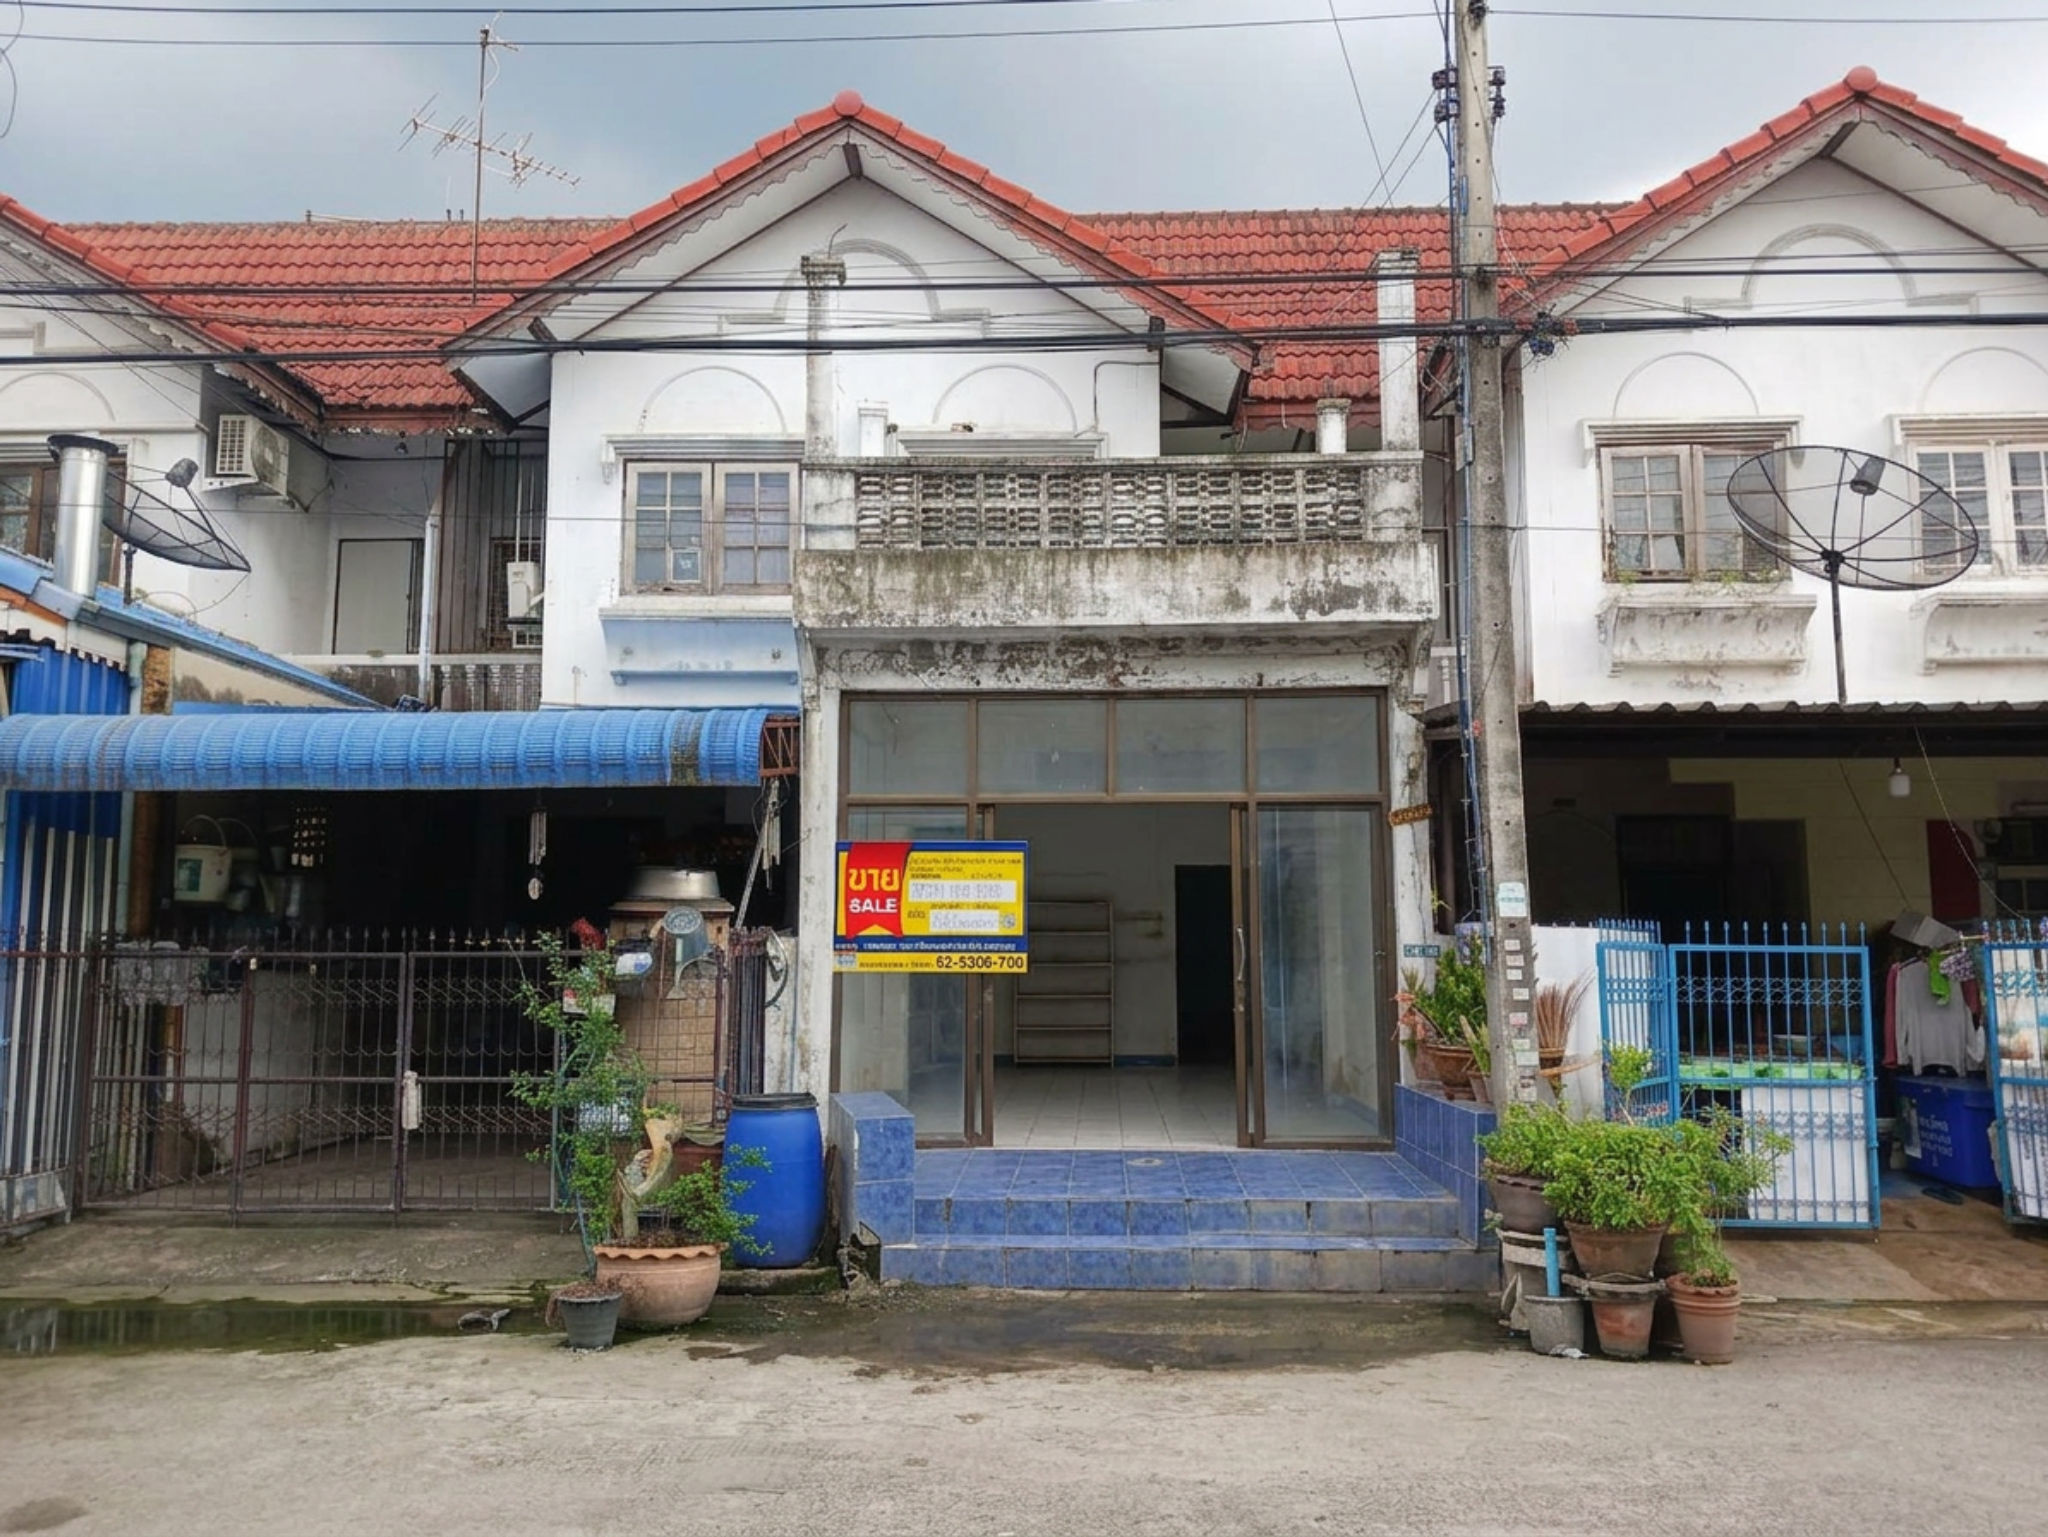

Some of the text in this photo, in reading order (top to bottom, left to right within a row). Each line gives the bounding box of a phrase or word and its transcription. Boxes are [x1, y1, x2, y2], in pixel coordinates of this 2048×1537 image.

[848, 868, 900, 892] ขาย
[849, 898, 898, 914] SALE
[936, 955, 1024, 969] 62-5306-700
